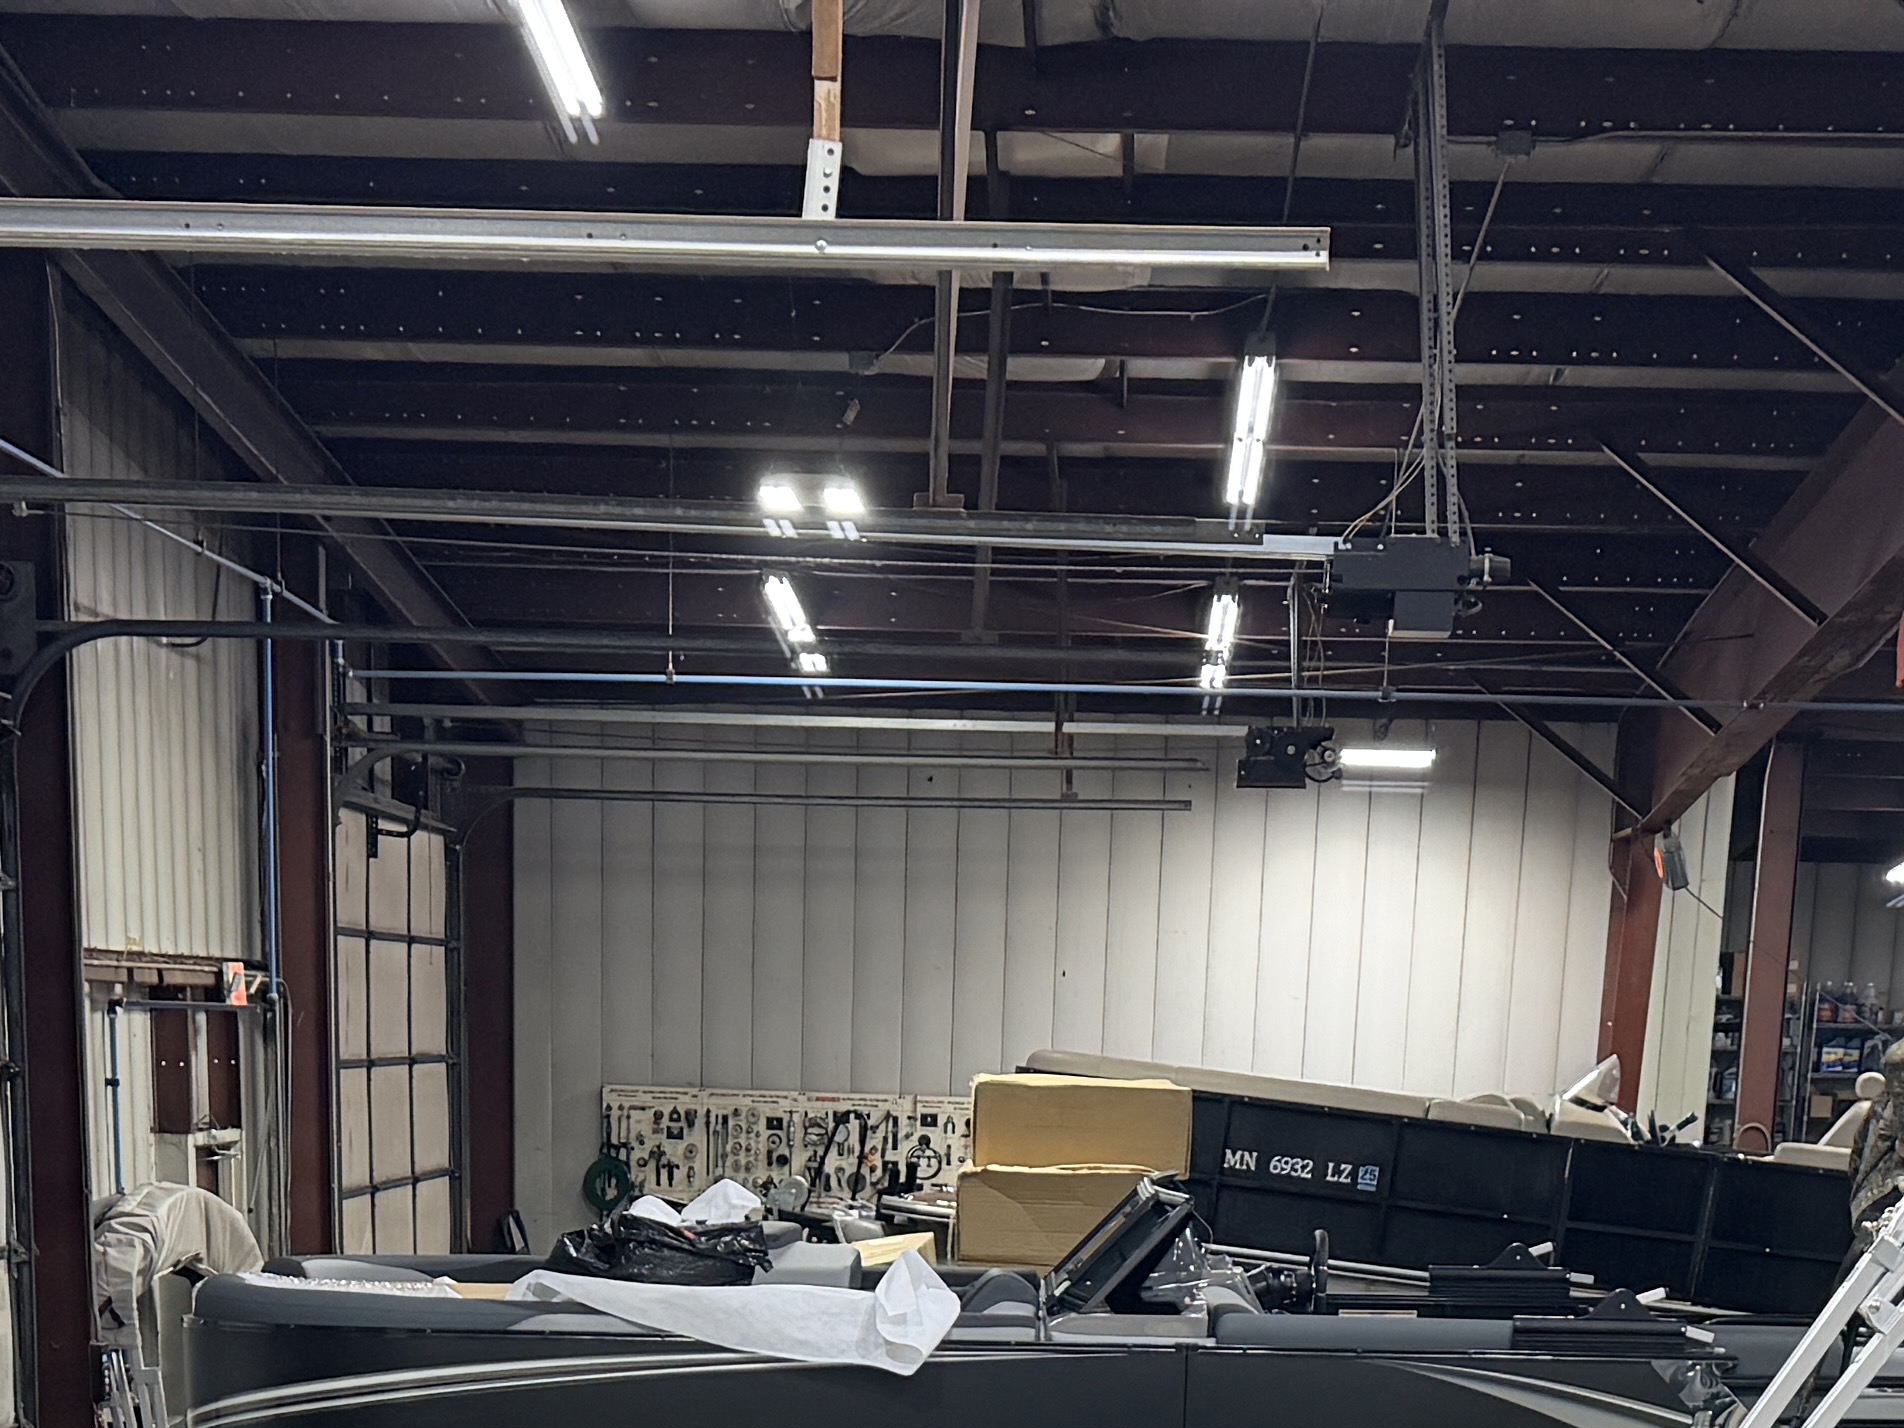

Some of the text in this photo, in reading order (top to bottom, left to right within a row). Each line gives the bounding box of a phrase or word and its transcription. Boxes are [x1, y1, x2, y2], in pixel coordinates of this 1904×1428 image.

[1223, 1149, 1353, 1184] MN 6932 LZ
